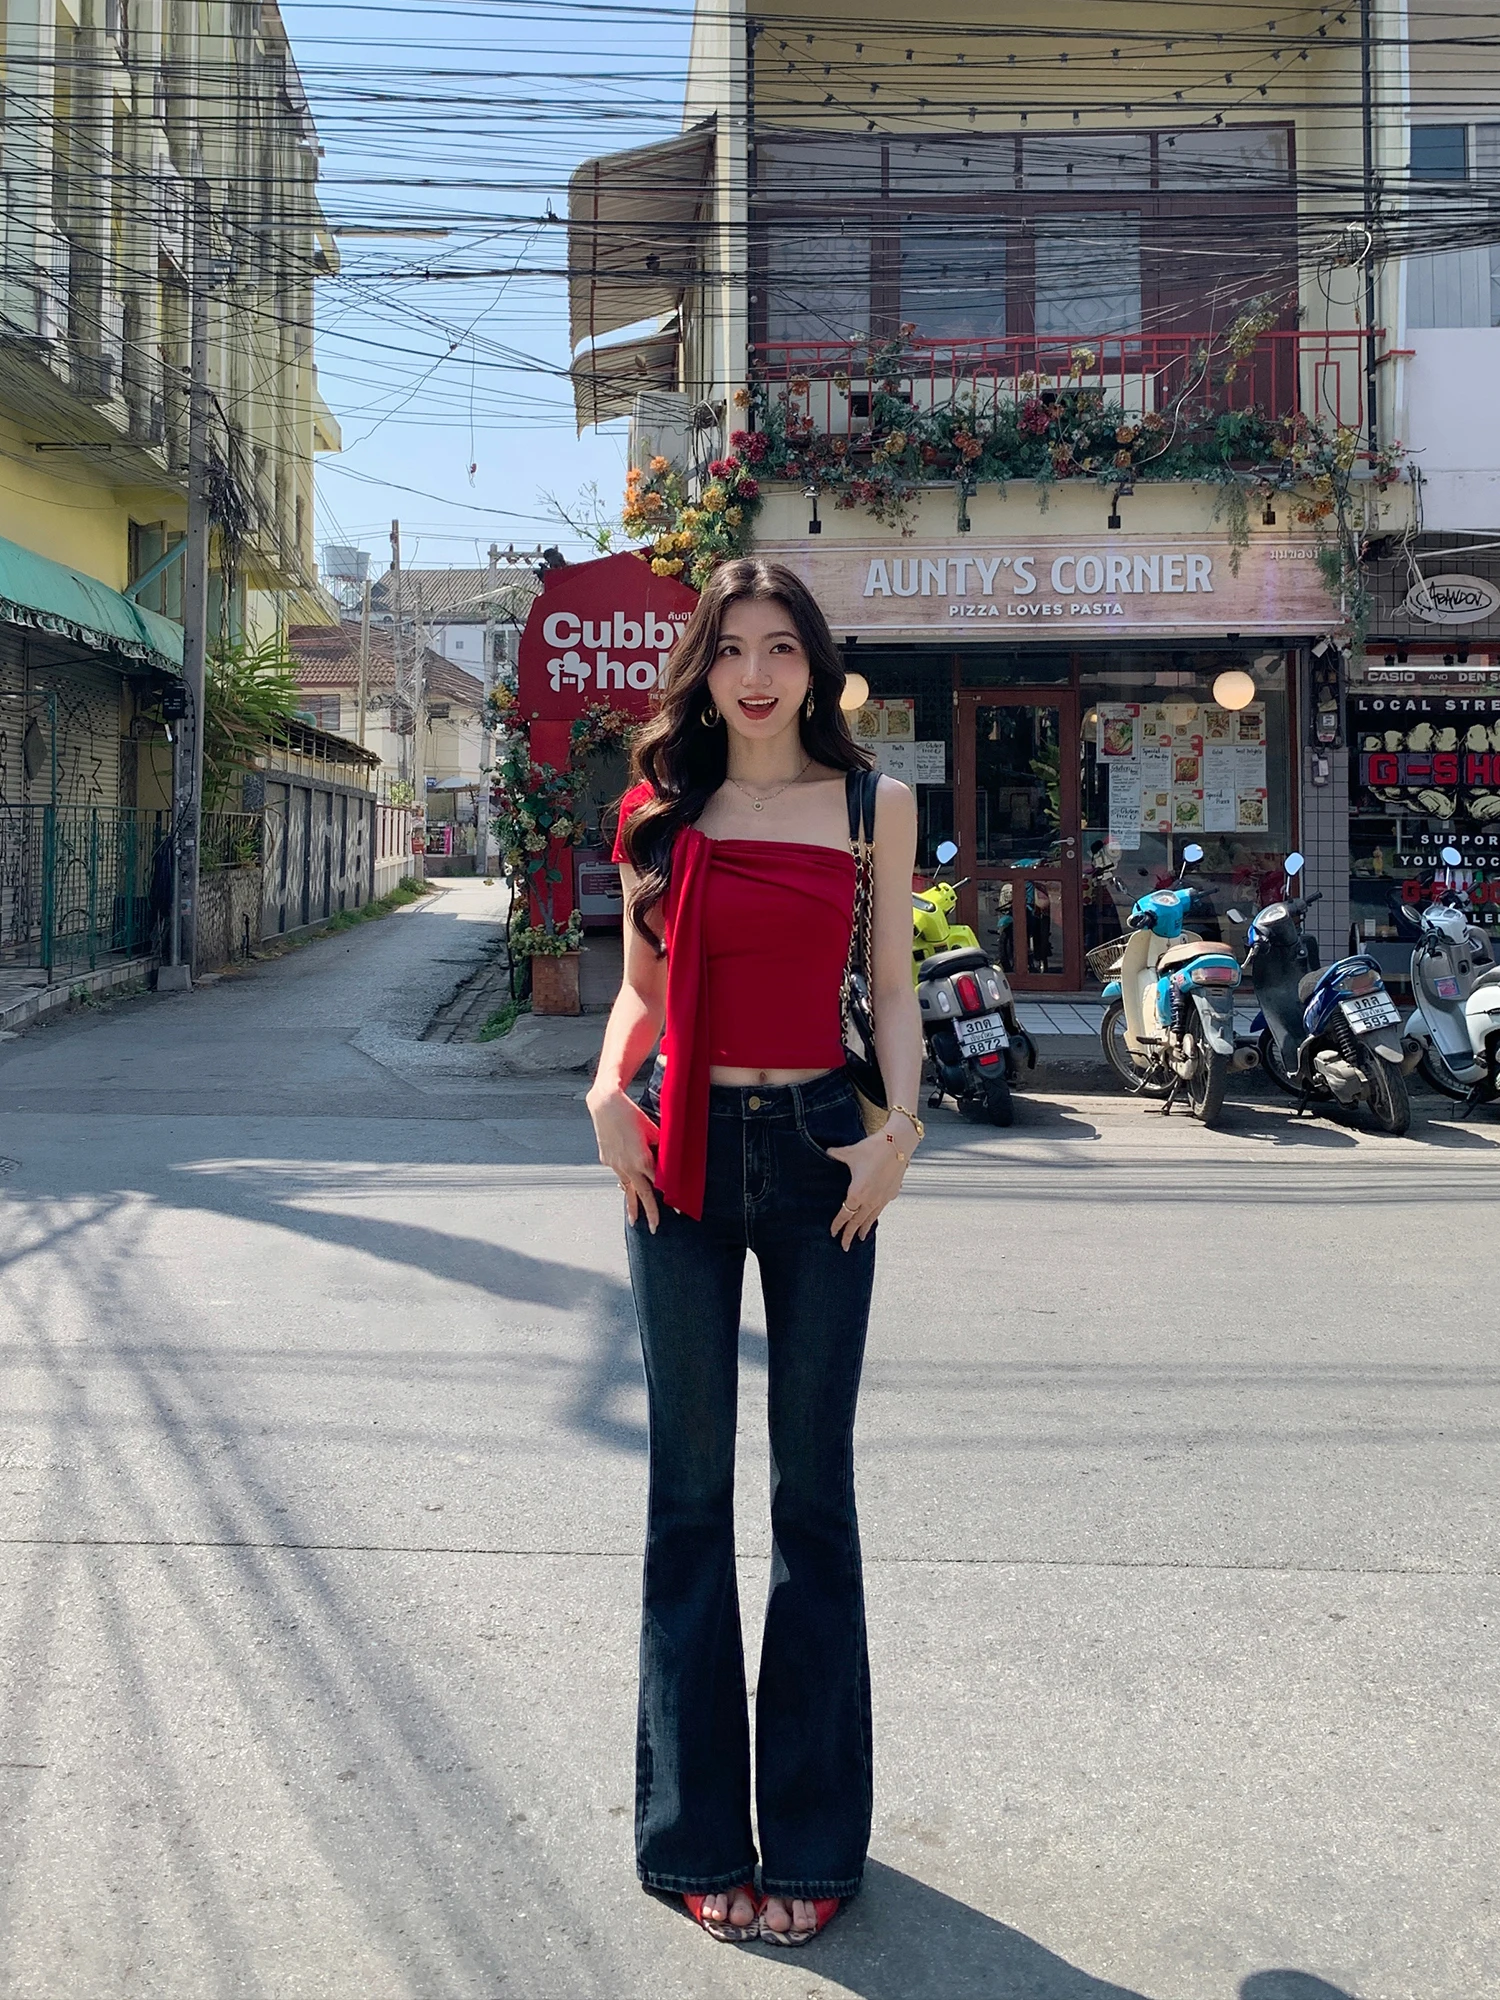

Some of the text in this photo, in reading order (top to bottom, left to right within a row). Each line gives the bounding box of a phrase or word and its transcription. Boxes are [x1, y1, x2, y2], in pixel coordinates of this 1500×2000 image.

[863, 554, 1214, 597] AUNTY'S CORNER
[949, 603, 1124, 617] PIZZA LOVES PASTA
[1368, 672, 1415, 682] CASIO
[1459, 673, 1485, 682] DEN
[1359, 699, 1500, 711] LOCAL STRE
[1421, 835, 1499, 845] SUPPOR
[1400, 856, 1500, 866] YOU LOC
[1363, 1014, 1390, 1029] 593
[969, 1038, 1002, 1054] 8872
